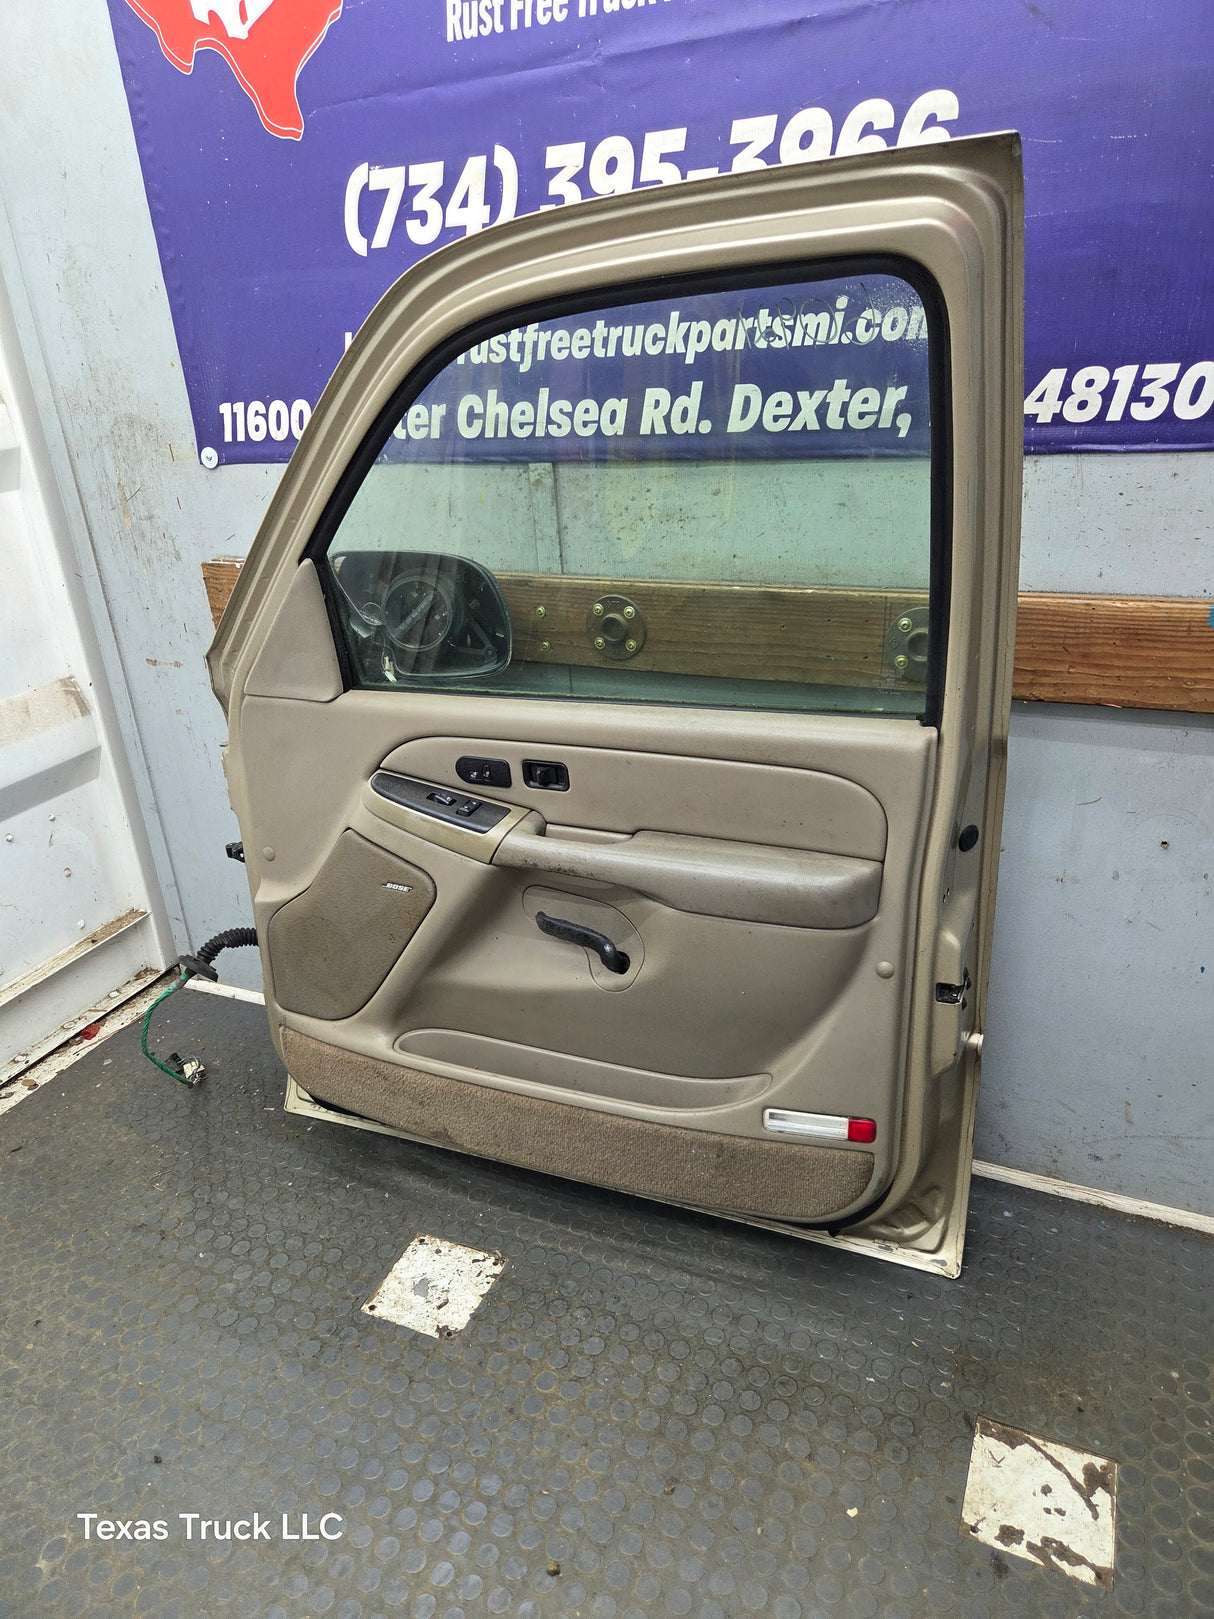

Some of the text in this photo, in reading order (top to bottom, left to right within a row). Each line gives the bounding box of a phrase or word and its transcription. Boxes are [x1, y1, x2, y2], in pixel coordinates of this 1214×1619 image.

[446, 0, 505, 42] Rust
[344, 89, 960, 257] (734) 395-3966
[219, 400, 313, 442] 11600
[457, 388, 629, 439] Chelsea
[640, 380, 712, 436] Rd.
[726, 378, 912, 438] Dexter,
[1023, 361, 1214, 424] 48130
[382, 882, 413, 893] BOSE
